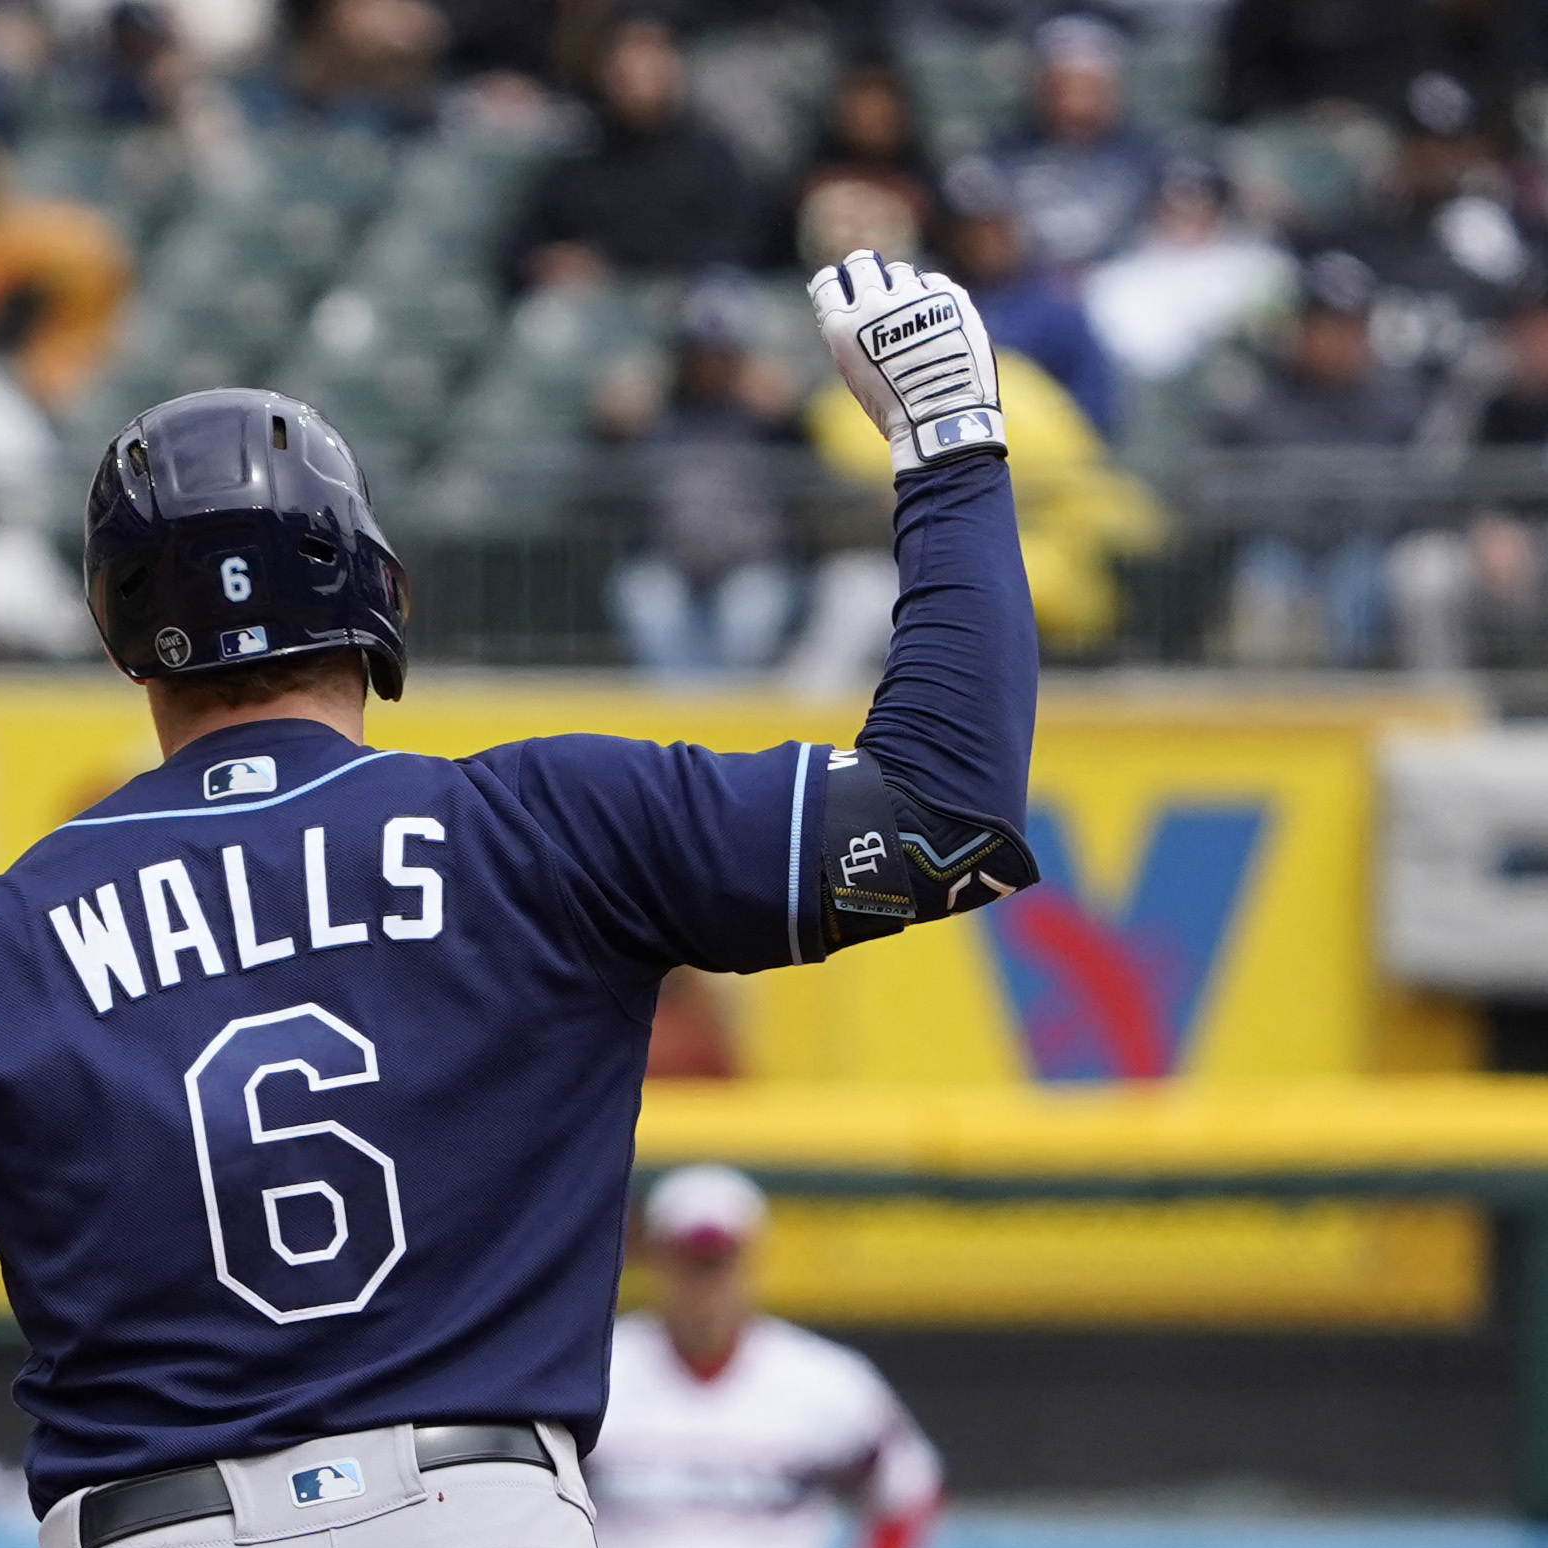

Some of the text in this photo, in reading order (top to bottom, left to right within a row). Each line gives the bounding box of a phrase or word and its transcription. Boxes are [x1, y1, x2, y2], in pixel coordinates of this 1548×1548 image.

[872, 303, 954, 357] Franklin
[219, 556, 253, 603] 6
[158, 633, 183, 650] DAVE
[839, 831, 888, 888] TB
[48, 816, 447, 1015] WALLS
[839, 902, 909, 915] EVOSHIELD
[184, 1001, 407, 1324] 6
